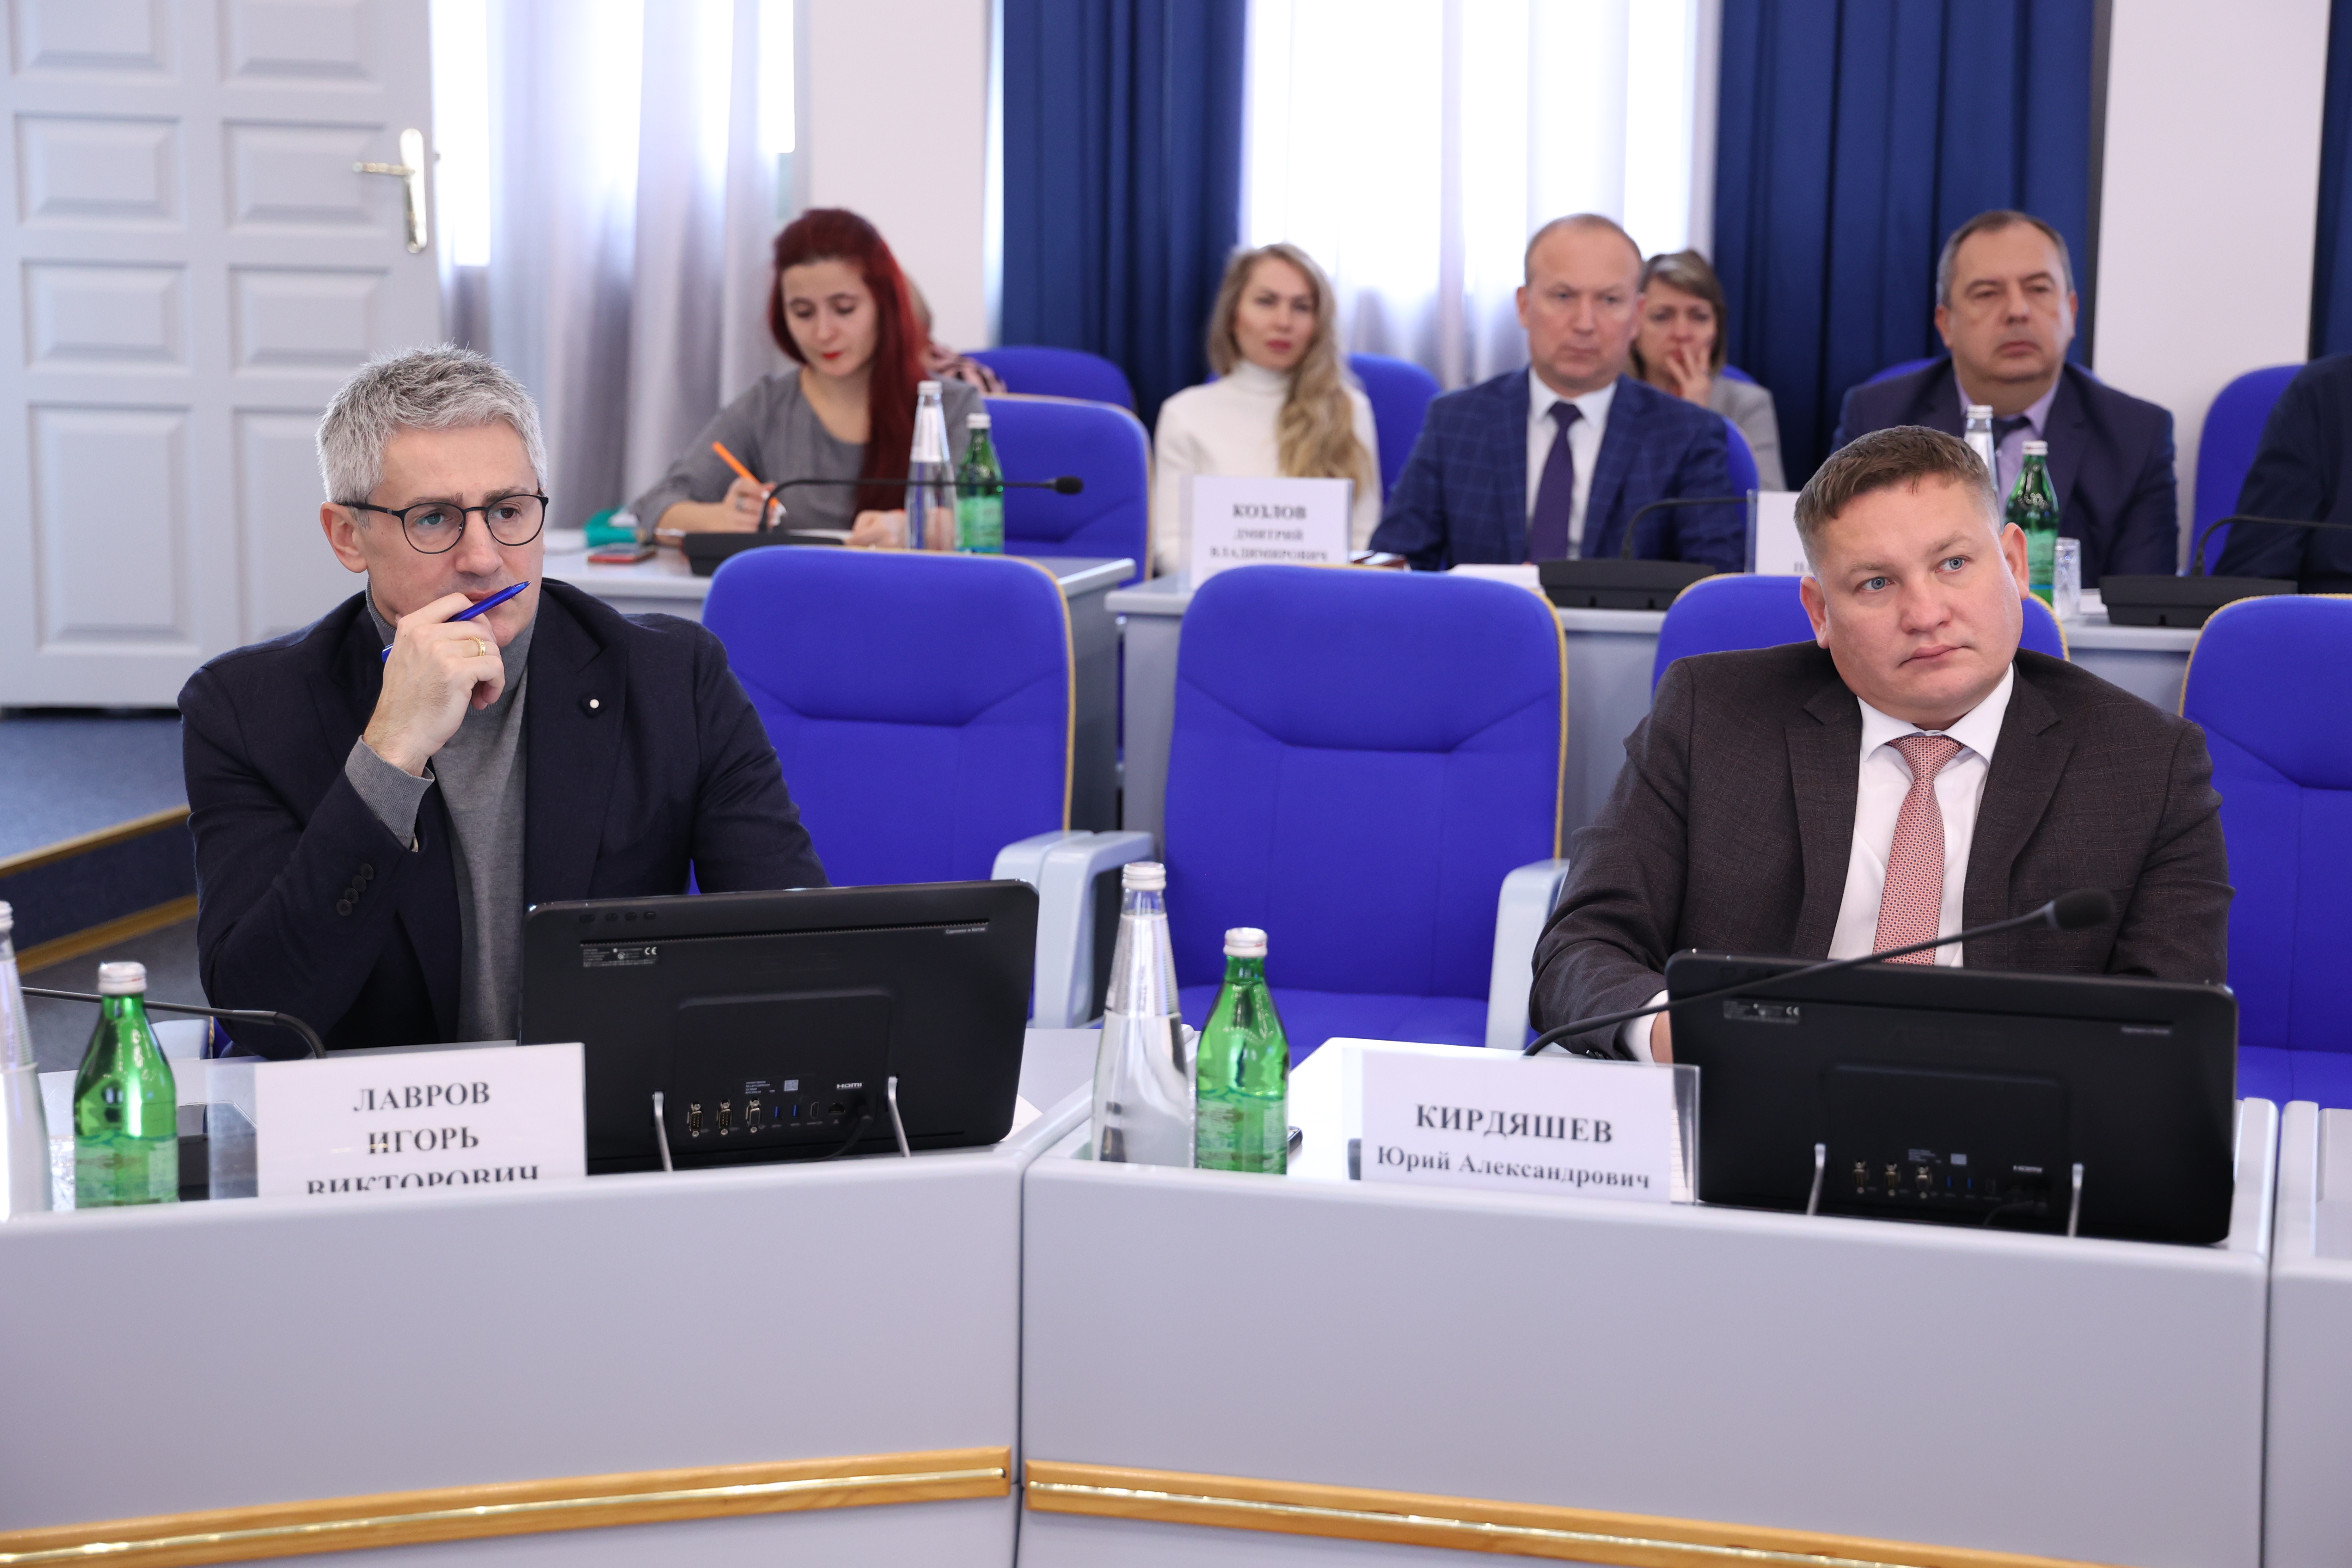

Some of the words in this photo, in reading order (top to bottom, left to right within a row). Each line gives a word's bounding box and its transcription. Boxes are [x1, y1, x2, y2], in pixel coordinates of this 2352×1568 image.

[1233, 504, 1306, 520] КОЗЛОВ
[353, 1082, 490, 1112] ЛАВРОВ
[1416, 1105, 1612, 1143] КИРДЯШЕВ
[368, 1127, 479, 1155] ИГОРЬ
[1377, 1146, 1450, 1173] Юрий
[1459, 1155, 1649, 1189] Александрович
